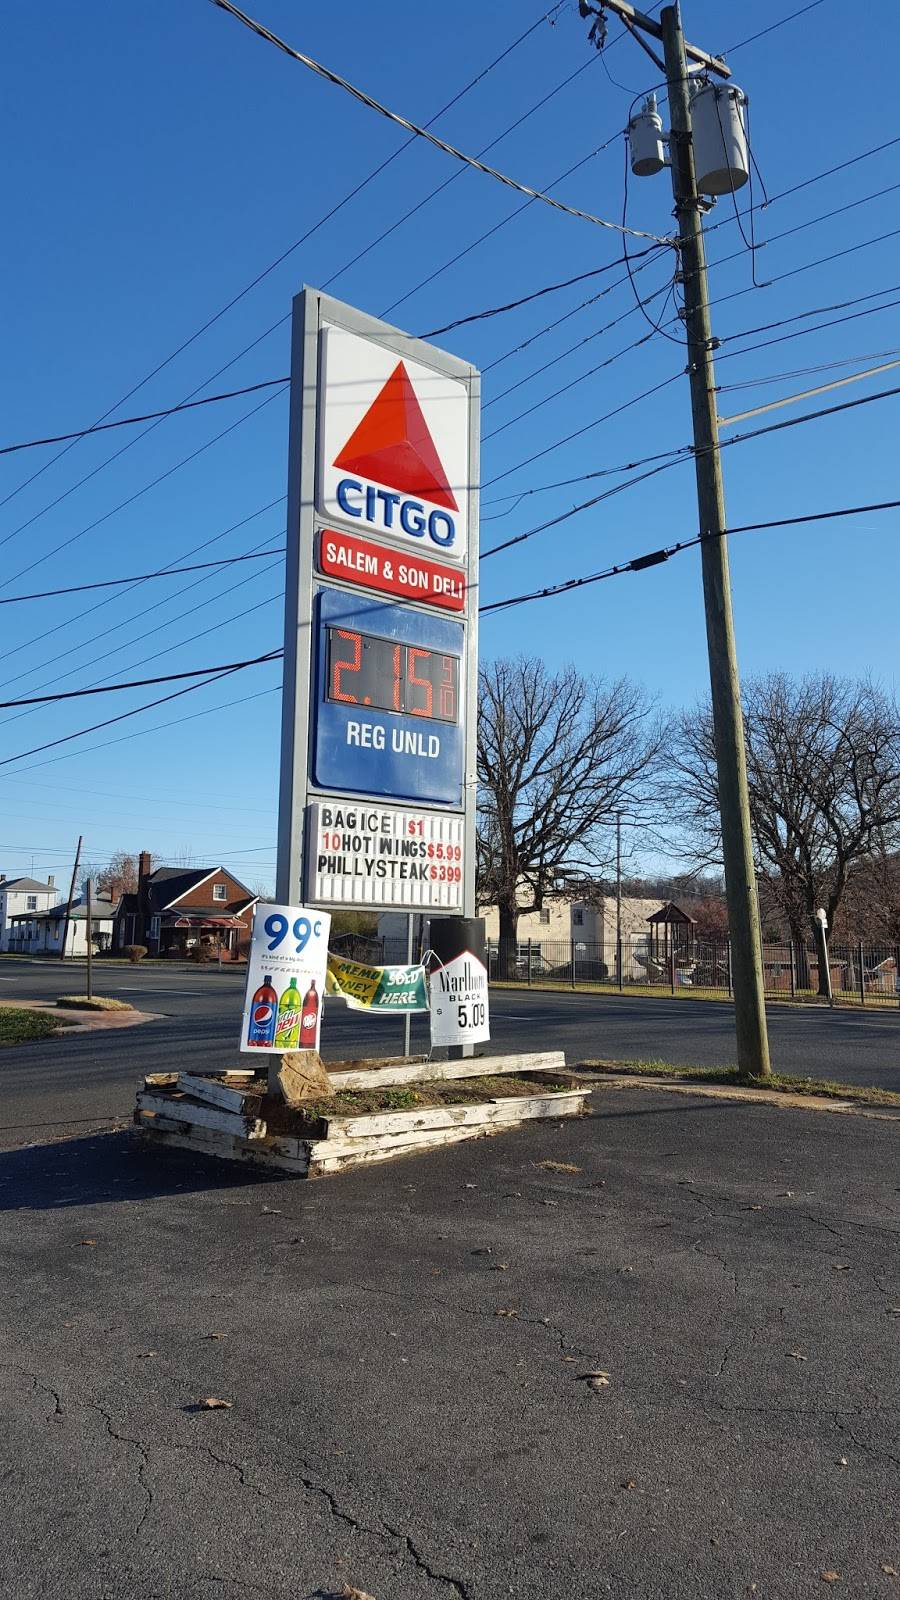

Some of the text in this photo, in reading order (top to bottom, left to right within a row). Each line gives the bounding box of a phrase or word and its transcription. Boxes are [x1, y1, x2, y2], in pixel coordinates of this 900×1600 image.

[336, 478, 456, 547] CITGO
[326, 542, 463, 599] SALEM & SON DELI
[346, 721, 440, 758] REG UNLD
[321, 808, 424, 836] BAG ICE $1
[387, 970, 419, 986] SOLD
[379, 991, 418, 1004] HERE
[449, 993, 481, 1002] BLACK
[458, 1003, 485, 1028] 5.09
